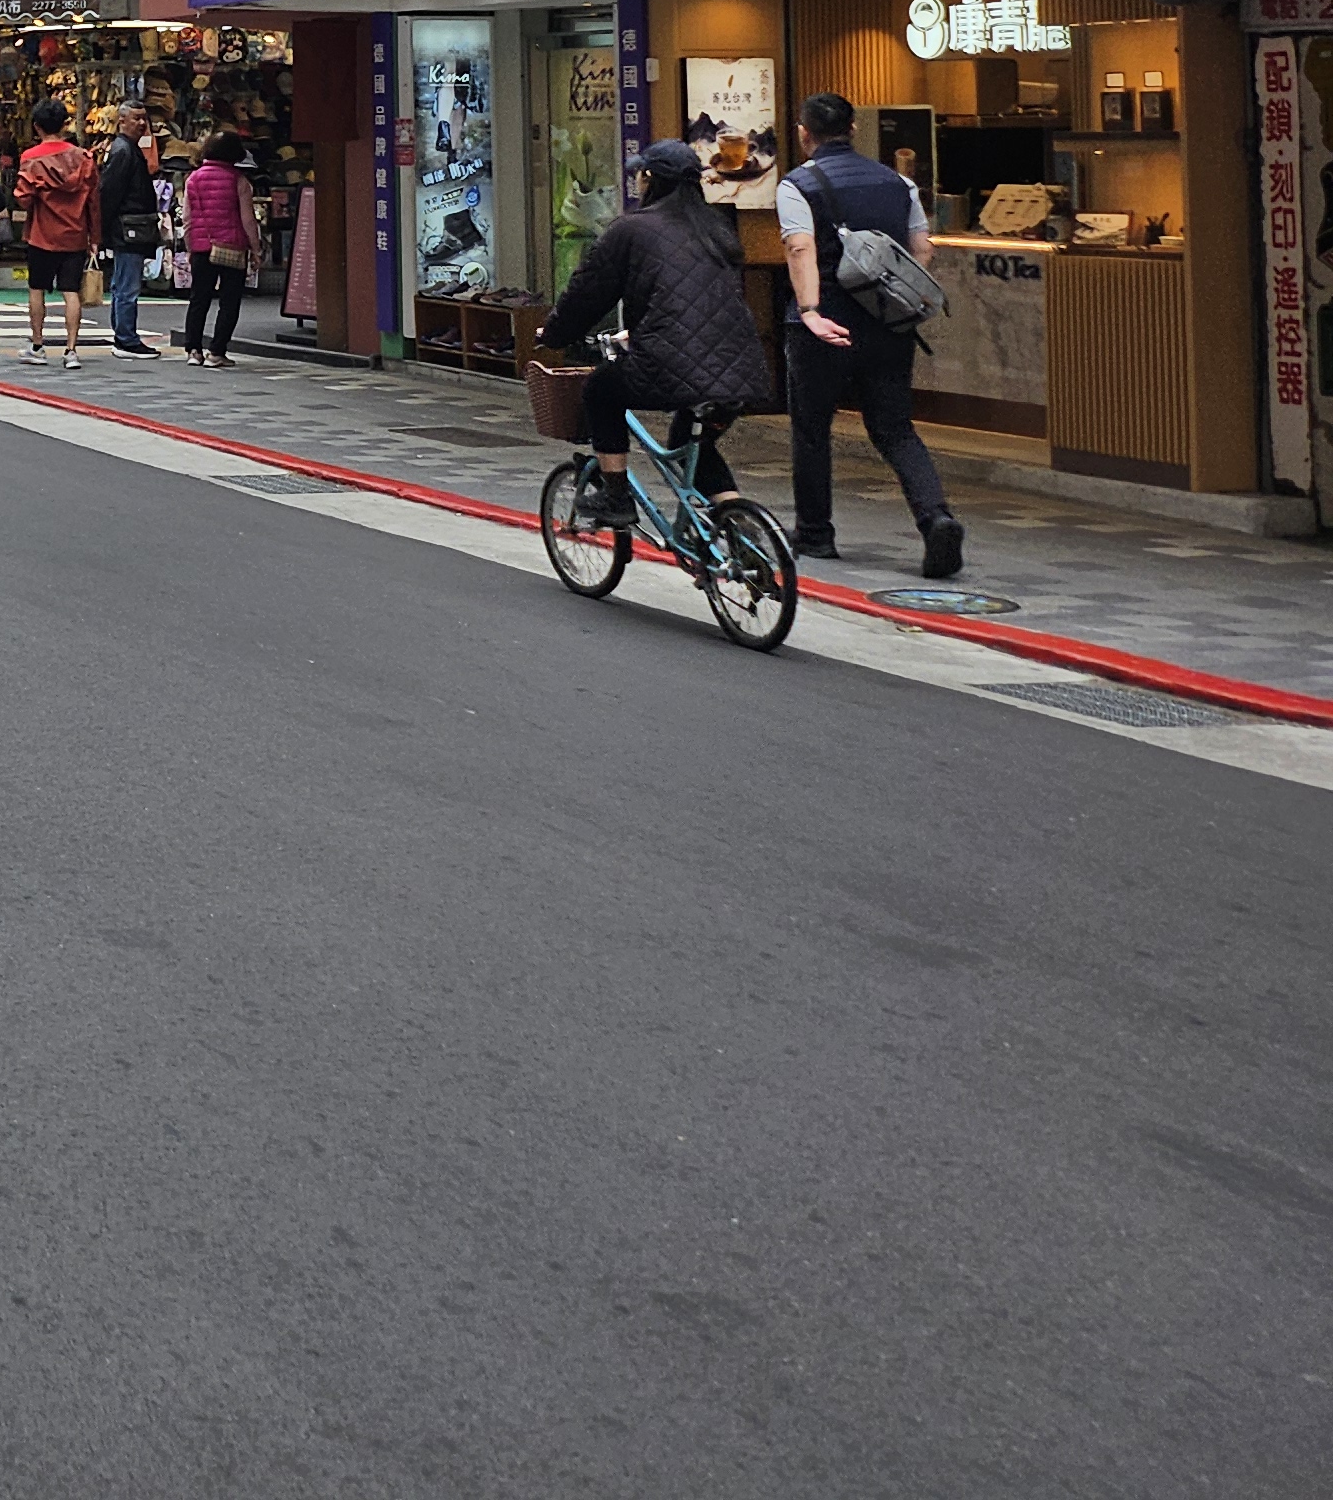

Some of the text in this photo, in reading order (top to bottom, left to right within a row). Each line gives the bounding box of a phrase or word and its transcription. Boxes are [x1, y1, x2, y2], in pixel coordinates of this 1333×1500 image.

[428, 63, 471, 84] Kimo
[974, 253, 1042, 281] KQ Tea
